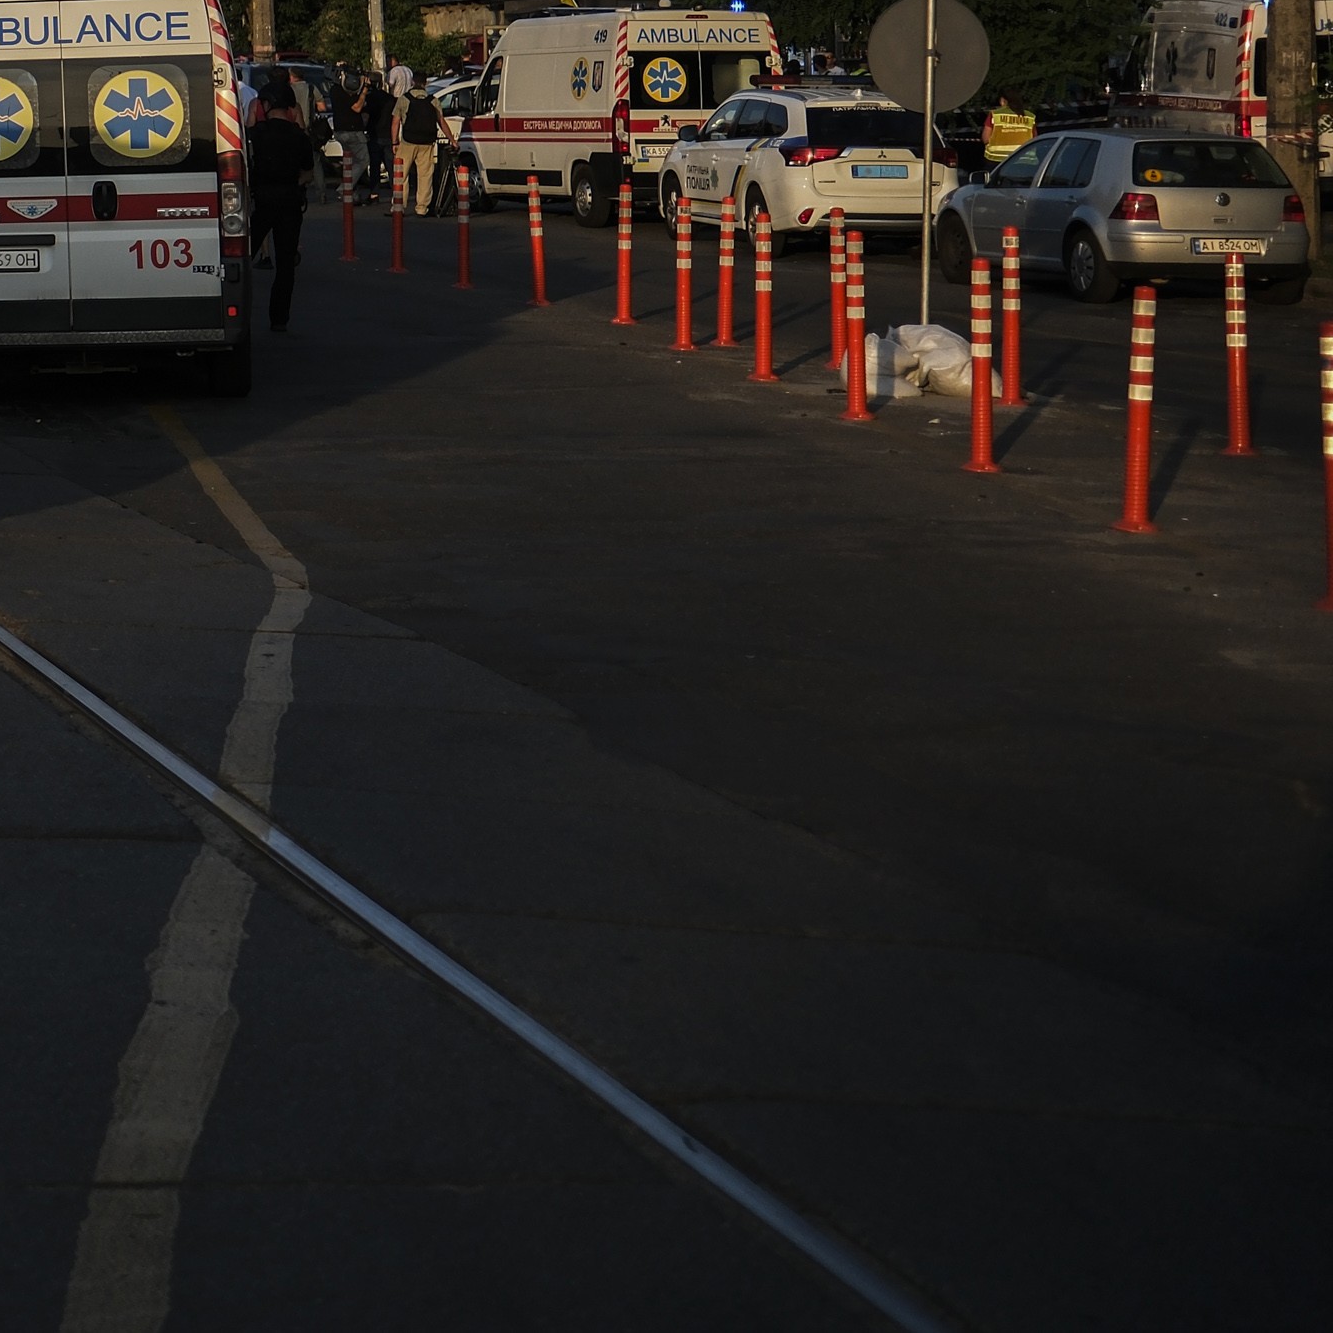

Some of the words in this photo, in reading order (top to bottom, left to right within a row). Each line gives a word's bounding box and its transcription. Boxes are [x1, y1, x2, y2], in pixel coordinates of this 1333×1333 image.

[1214, 12, 1228, 27] 422
[594, 29, 608, 43] 419
[636, 28, 761, 43] AMBULANCE
[523, 120, 547, 130] ЕКСТРЕНА
[548, 120, 573, 131] МЕДИЧНА
[573, 120, 602, 131] ДОПОМОГА
[687, 177, 710, 190] ПОЛІЦІЯ
[1244, 241, 1258, 251] OM
[15, 253, 36, 266] OH
[129, 238, 193, 269] 103
